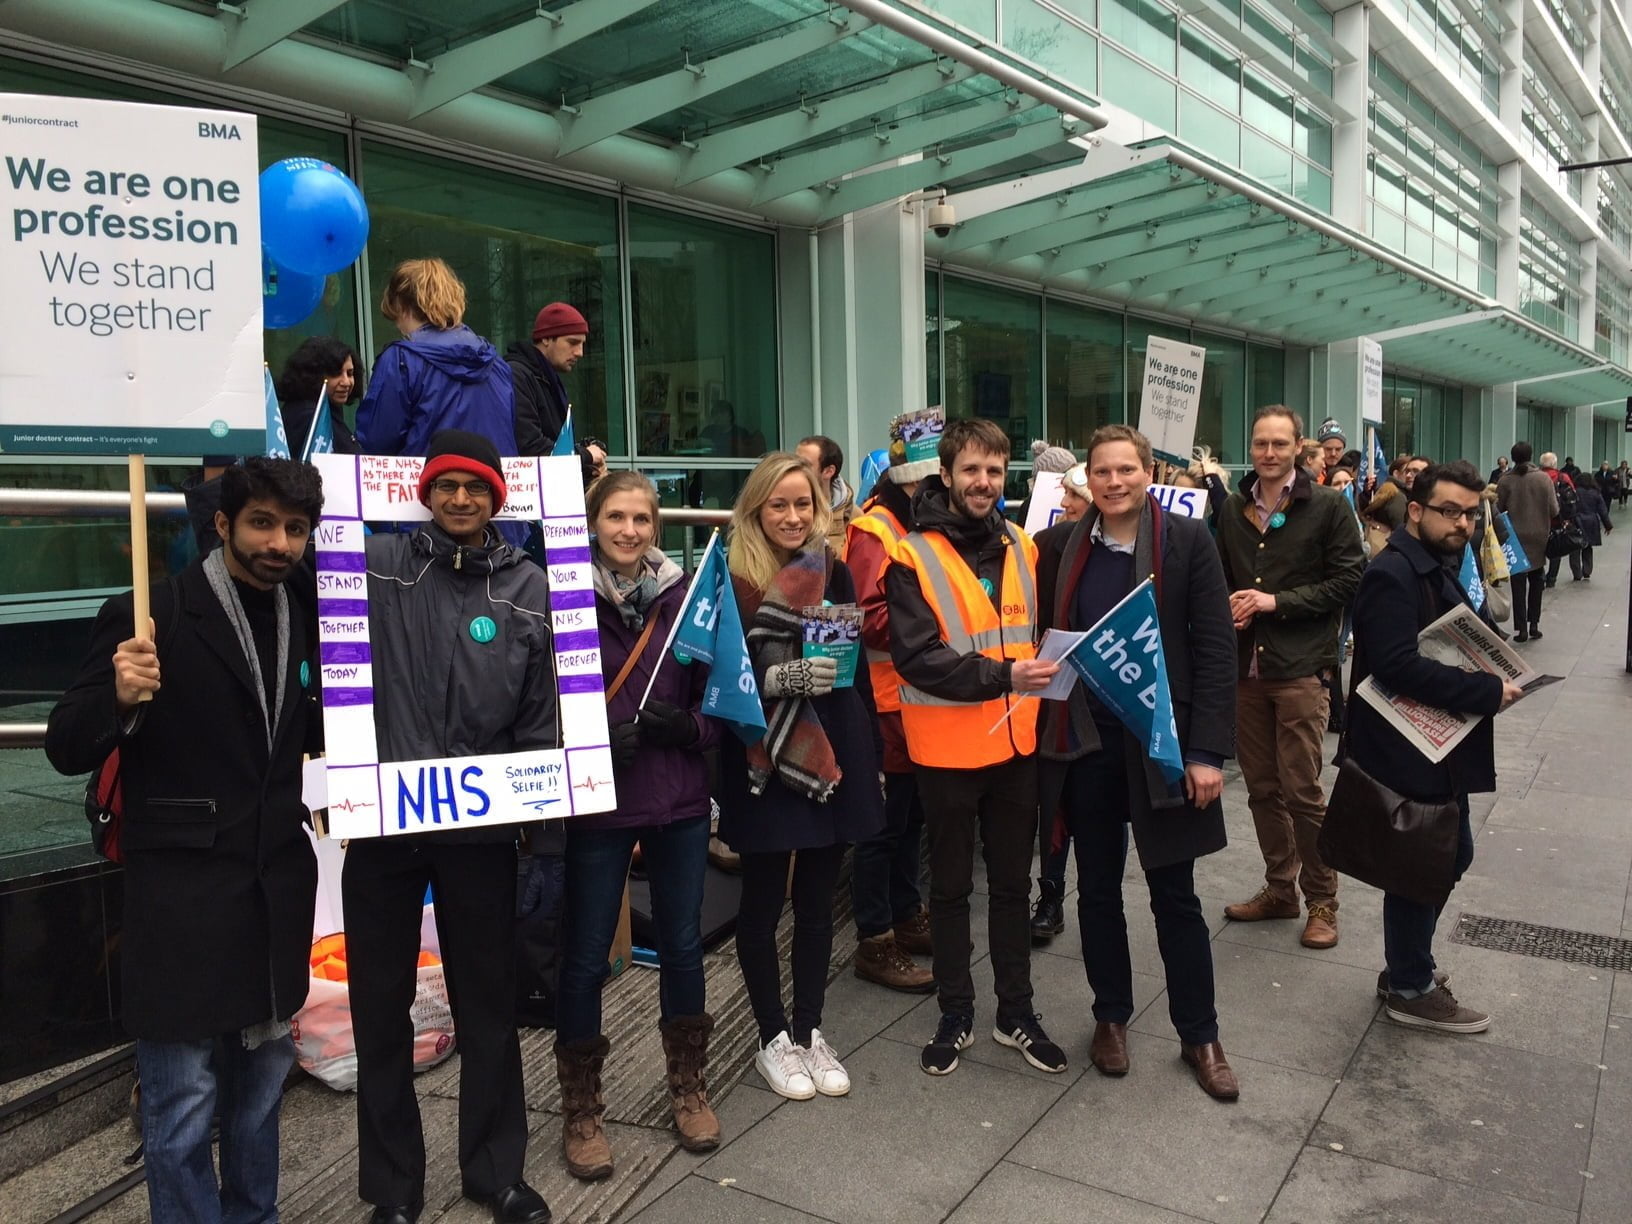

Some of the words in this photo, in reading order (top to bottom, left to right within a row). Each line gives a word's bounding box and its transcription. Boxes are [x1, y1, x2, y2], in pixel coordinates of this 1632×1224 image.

[1, 114, 79, 128] #juniorcontract
[197, 121, 242, 141] BMA
[5, 156, 71, 193] We
[83, 169, 151, 198] are
[162, 175, 241, 204] one
[13, 204, 239, 246] profession
[39, 250, 100, 286] We
[113, 258, 215, 292] stand
[49, 296, 212, 336] together
[1190, 350, 1201, 358] BMA
[1149, 356, 1163, 371] We
[1163, 363, 1179, 376] are
[1180, 367, 1198, 381] one
[1147, 373, 1196, 395] profession
[1151, 389, 1164, 404] We
[1165, 392, 1188, 410] stand
[1151, 403, 1185, 423] together
[13, 434, 34, 442] Junior
[64, 435, 93, 443] contract
[143, 436, 159, 445] fight
[395, 458, 422, 470] NHS
[363, 469, 374, 480] AS
[375, 470, 405, 481] THERE
[409, 471, 420, 481] AR
[503, 471, 519, 480] TH
[363, 481, 381, 491] THE
[387, 482, 420, 503] FAIT
[503, 503, 534, 513] Bevan
[318, 525, 344, 544] WE
[544, 524, 588, 538] DEFENDING
[318, 575, 363, 590] STAND
[551, 568, 578, 584] YOUR
[320, 620, 365, 634] TOGETHER
[555, 612, 583, 627] NHS
[1092, 628, 1143, 684] the
[1453, 616, 1493, 653] Socialist
[1487, 648, 1522, 680] Appeal
[558, 652, 598, 669] FOREVER
[323, 667, 358, 680] TODAY
[505, 763, 562, 779] SOLIDARITY
[511, 780, 545, 794] SELFIE
[397, 765, 491, 830] NHS
